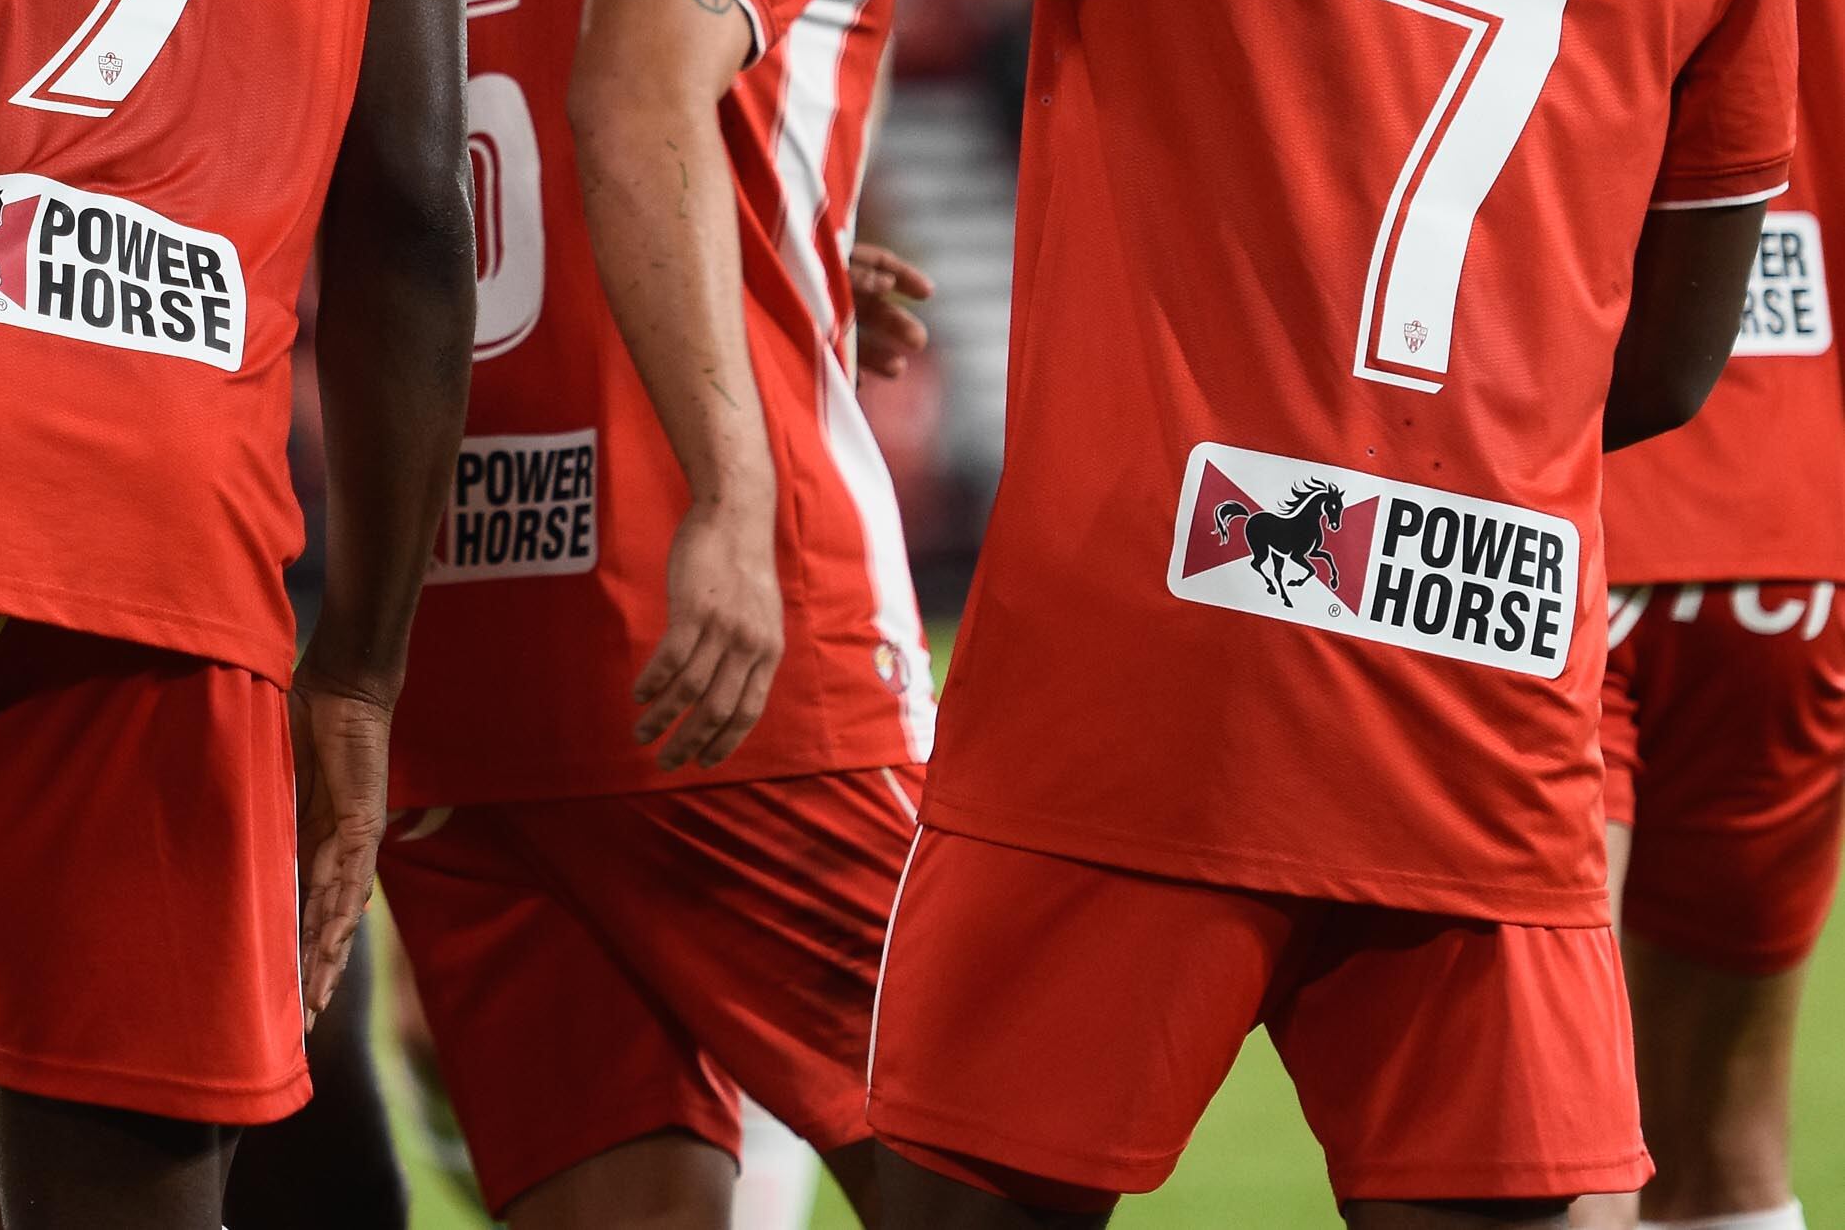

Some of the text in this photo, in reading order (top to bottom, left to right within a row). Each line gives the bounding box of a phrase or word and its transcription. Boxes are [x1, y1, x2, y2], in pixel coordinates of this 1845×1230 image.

[39, 198, 229, 293] POWER
[38, 259, 231, 355] HORSE
[457, 446, 593, 507] POWER
[456, 503, 592, 567] HORSE
[1381, 497, 1565, 595] POWER
[1369, 563, 1562, 660] HORSE
